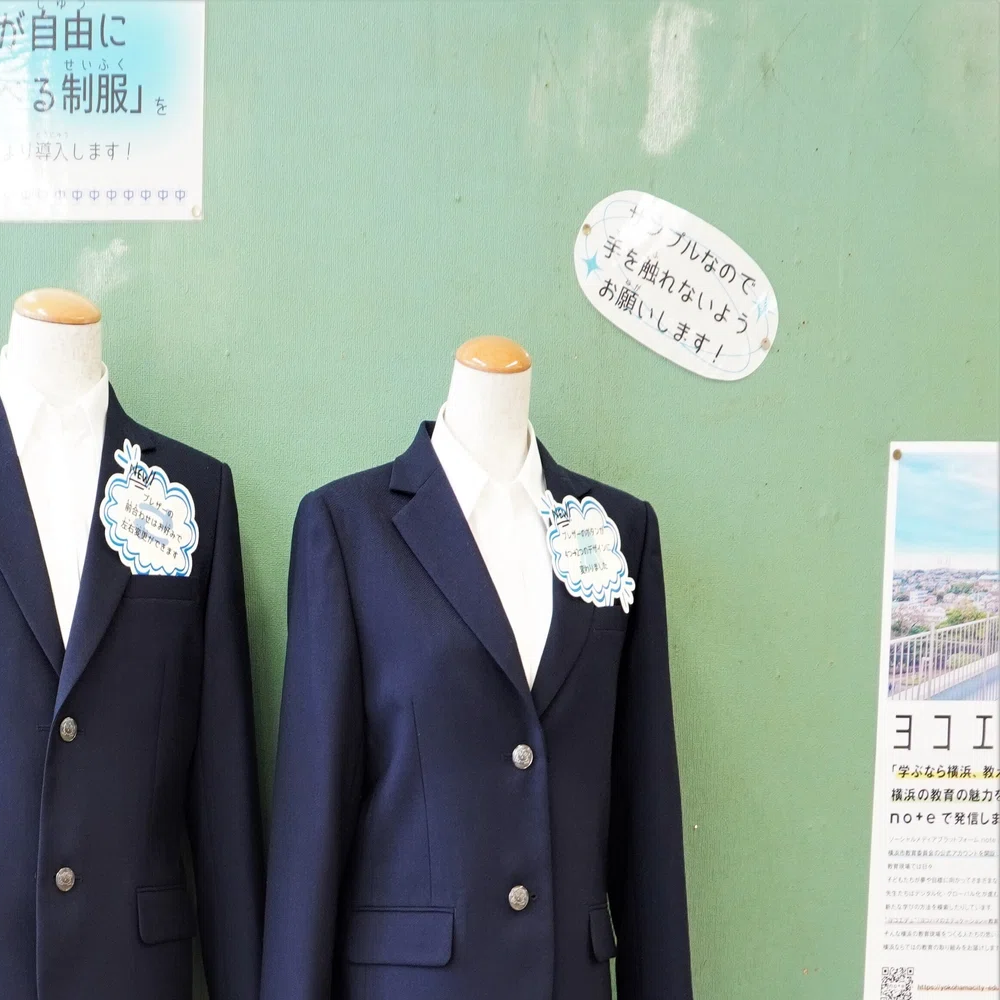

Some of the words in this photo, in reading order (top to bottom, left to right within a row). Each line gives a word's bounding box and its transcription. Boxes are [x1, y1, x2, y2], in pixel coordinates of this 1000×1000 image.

[63, 59, 125, 71] せいふく
[603, 235, 748, 334] 手を触れないよう
[893, 715, 994, 750] ヨコエ
